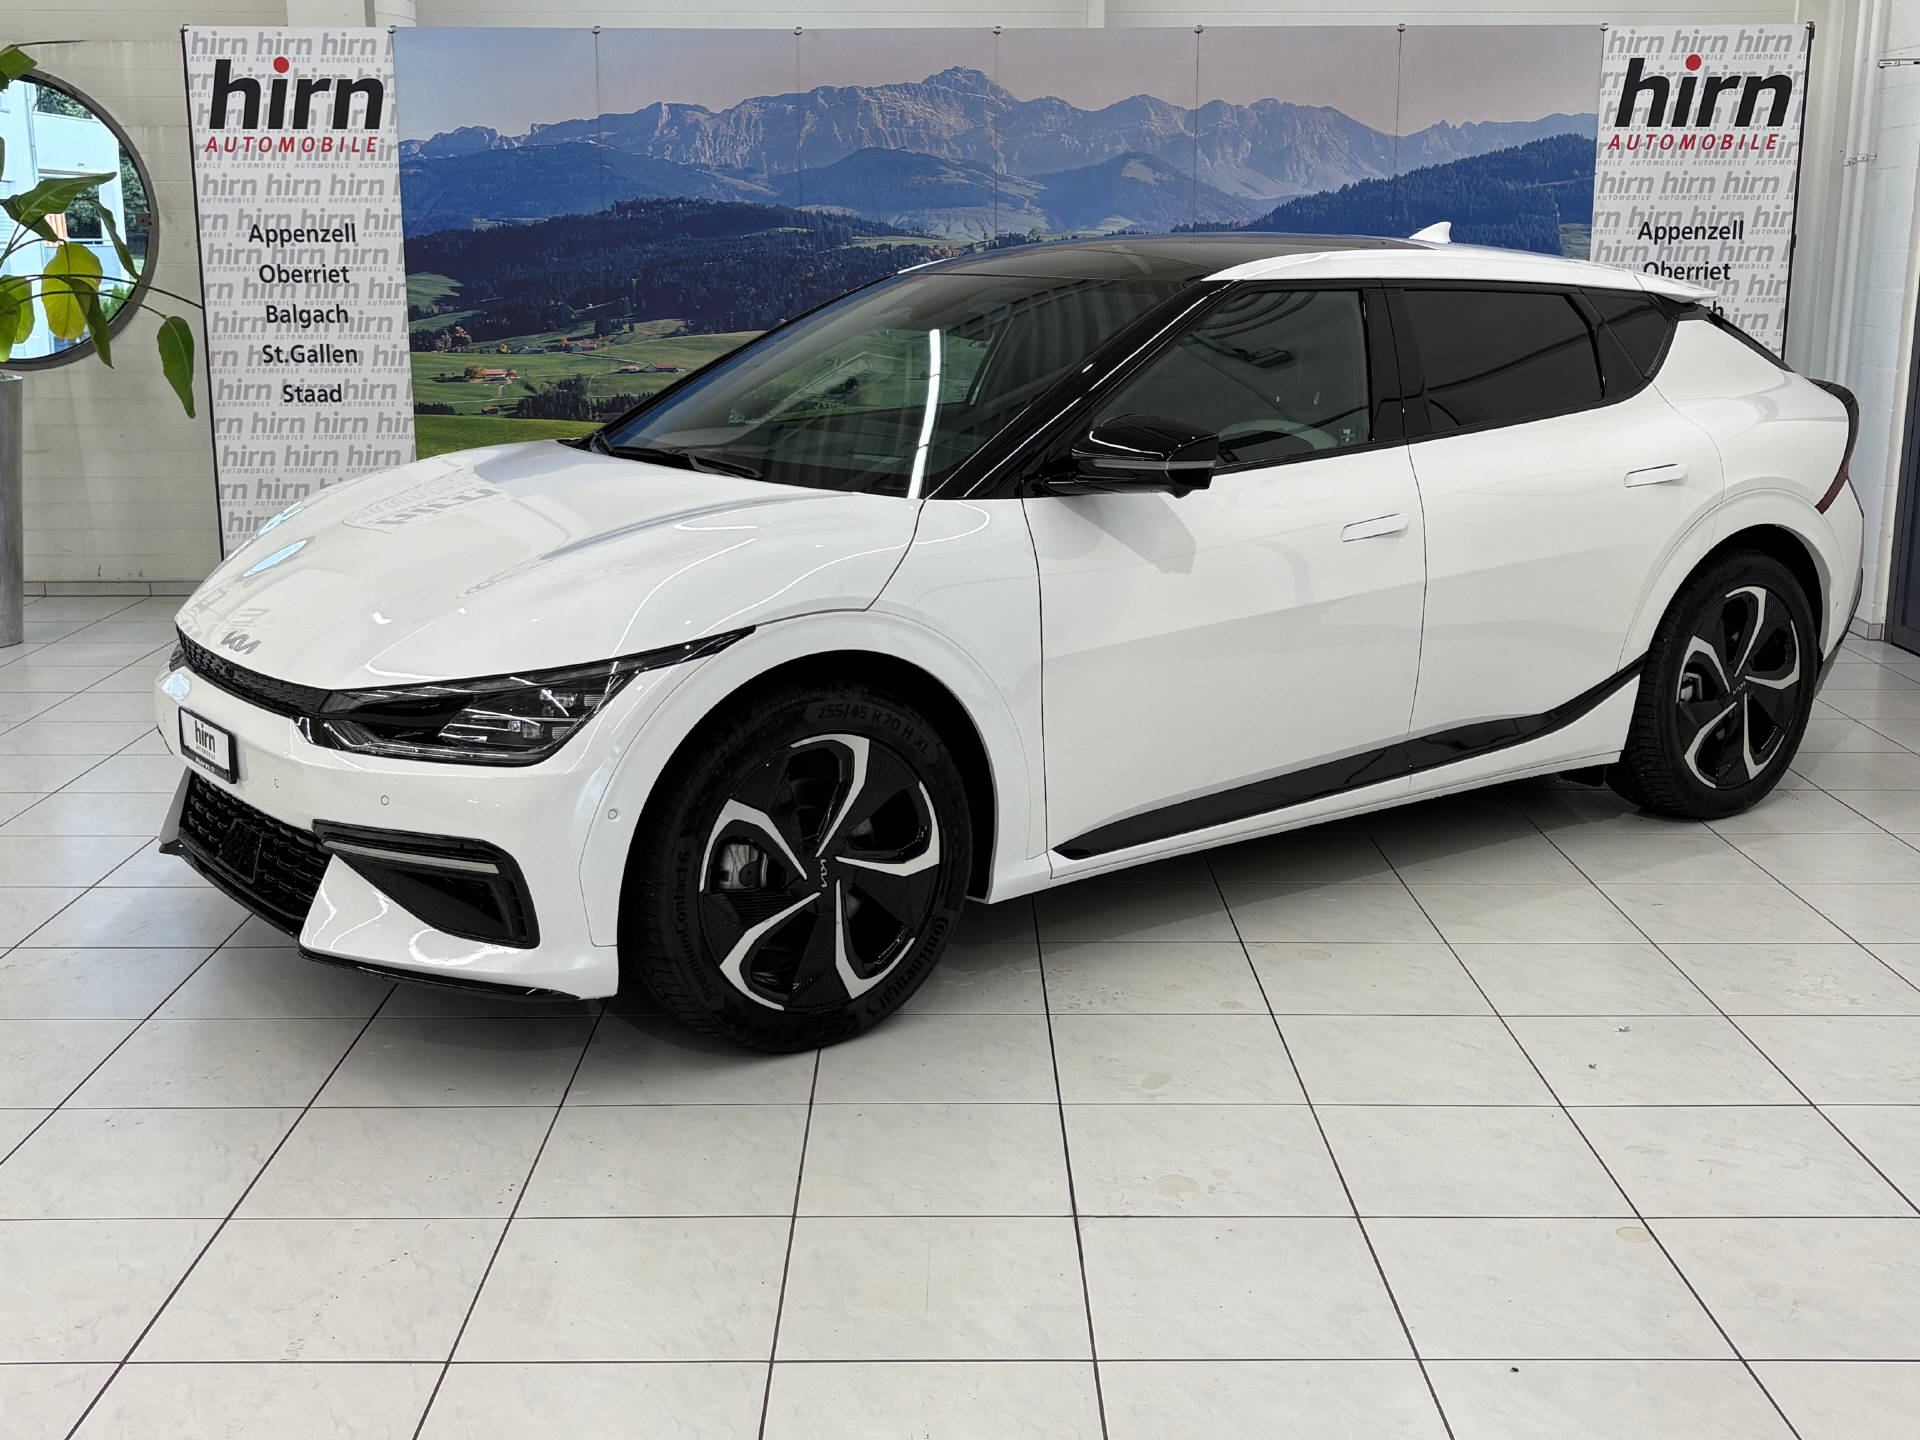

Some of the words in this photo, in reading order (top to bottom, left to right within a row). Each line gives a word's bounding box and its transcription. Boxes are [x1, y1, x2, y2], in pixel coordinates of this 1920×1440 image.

[192, 31, 248, 55] hirn
[256, 31, 312, 55] hirn
[321, 31, 377, 55] hirn
[1608, 29, 1664, 53] hirn
[1672, 29, 1728, 53] hirn
[1735, 29, 1793, 53] hirn
[209, 57, 384, 129] hirn
[1615, 54, 1792, 127] hirn
[205, 137, 378, 153] AUTOMOBILE
[1608, 134, 1779, 150] AUTOMOBILE
[202, 173, 257, 195] hirn
[266, 173, 321, 195] hirn
[330, 173, 384, 195] hirn
[1599, 171, 1654, 193] hirn
[1661, 171, 1716, 193] hirn
[1722, 171, 1780, 193] hirn
[248, 223, 356, 248] Appenzell
[1638, 220, 1744, 245] Appenzell
[207, 243, 261, 264] hirn
[270, 243, 324, 264] hirn
[335, 243, 389, 264] hirn
[1594, 240, 1649, 262] hirn
[1656, 240, 1710, 262] hirn
[1717, 240, 1774, 262] hirn
[259, 264, 350, 283] Oberriet
[1643, 261, 1731, 280] Oberriet
[243, 277, 297, 299] hirn
[305, 277, 359, 299] hirn
[213, 311, 267, 333] hirn
[266, 304, 349, 328] Balgach
[262, 344, 358, 364] St.Gallen
[218, 379, 272, 400] hirn
[344, 379, 397, 400] hirn
[283, 384, 342, 403] Staad
[252, 412, 305, 433] hirn
[314, 412, 368, 433] hirn
[222, 445, 276, 466] hirn
[284, 445, 339, 466] hirn
[347, 445, 401, 466] hirn
[256, 479, 310, 499] hirn
[195, 720, 216, 753] hirn
